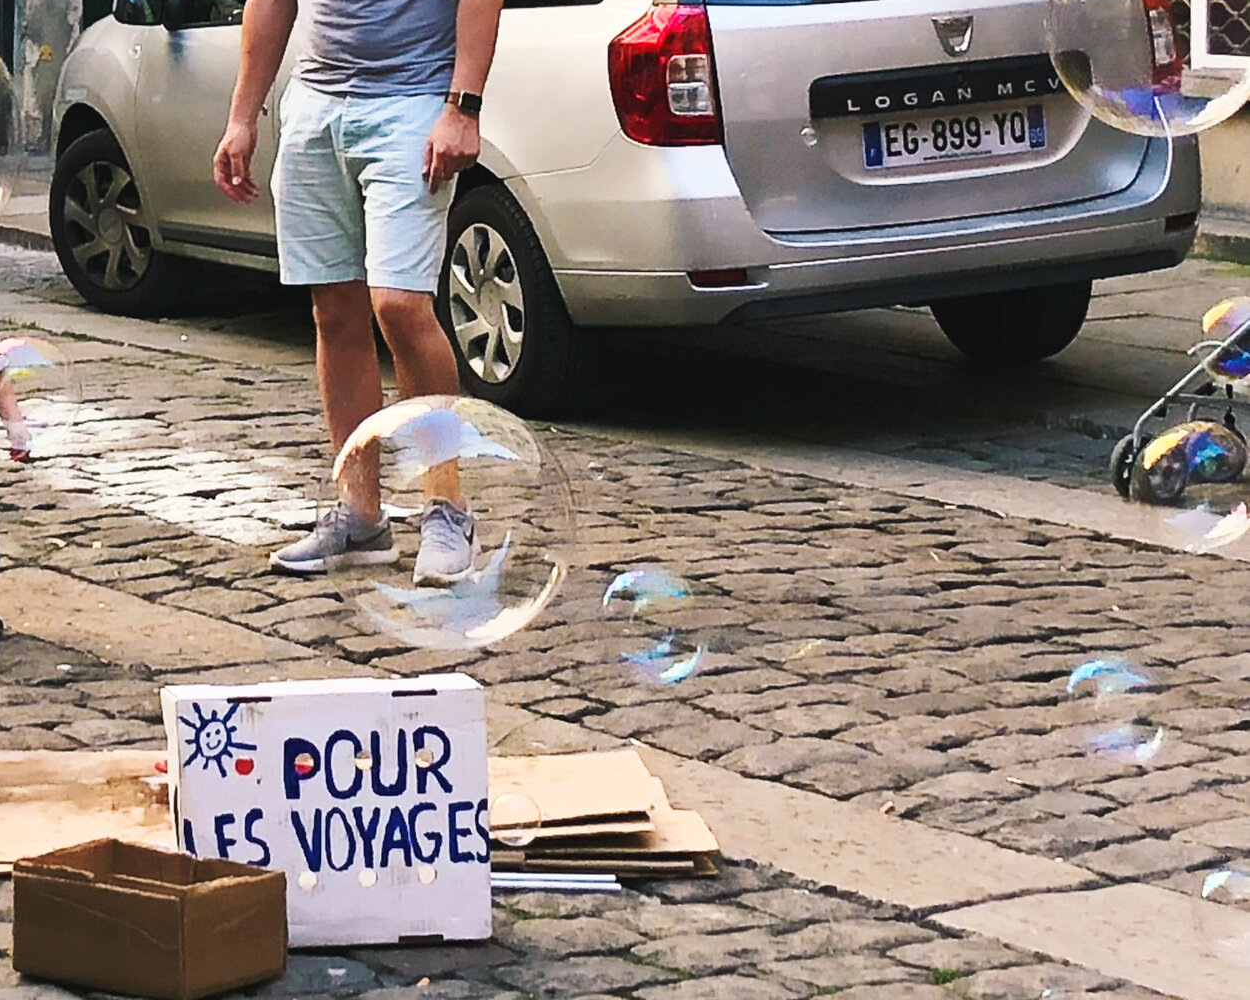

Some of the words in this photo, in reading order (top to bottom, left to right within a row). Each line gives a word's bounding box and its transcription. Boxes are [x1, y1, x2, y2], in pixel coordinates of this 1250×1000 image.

[847, 87, 972, 112] LOGAN
[997, 78, 1060, 96] MCV
[284, 725, 453, 800] POUR
[290, 798, 490, 872] VOYAGES
